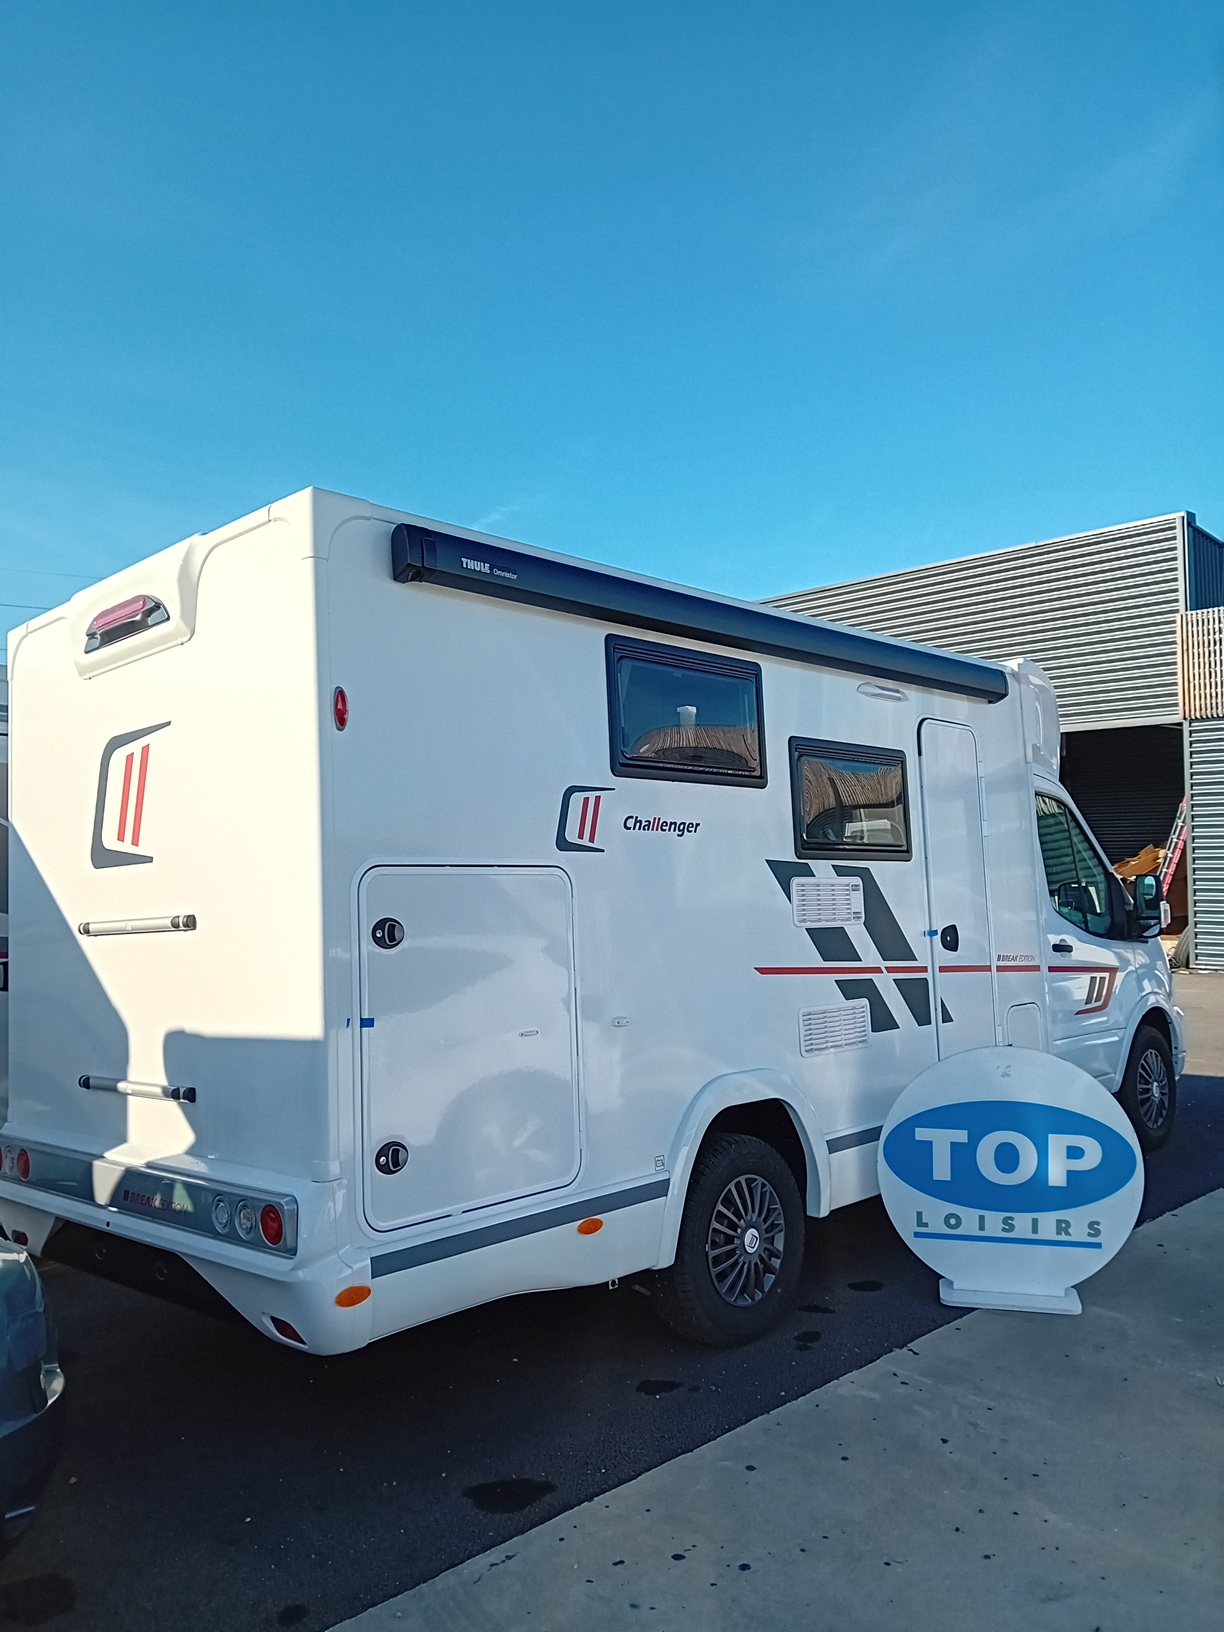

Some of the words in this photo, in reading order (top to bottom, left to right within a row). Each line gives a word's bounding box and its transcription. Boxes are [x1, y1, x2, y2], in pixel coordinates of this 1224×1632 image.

[461, 557, 490, 574] THULE
[493, 568, 518, 580] Omnistor
[623, 815, 701, 838] Challenger
[1001, 954, 1018, 962] BREAK
[914, 1127, 1103, 1187] TOP
[129, 1192, 158, 1209] BREAK
[915, 1210, 1103, 1238] LOISIRS
